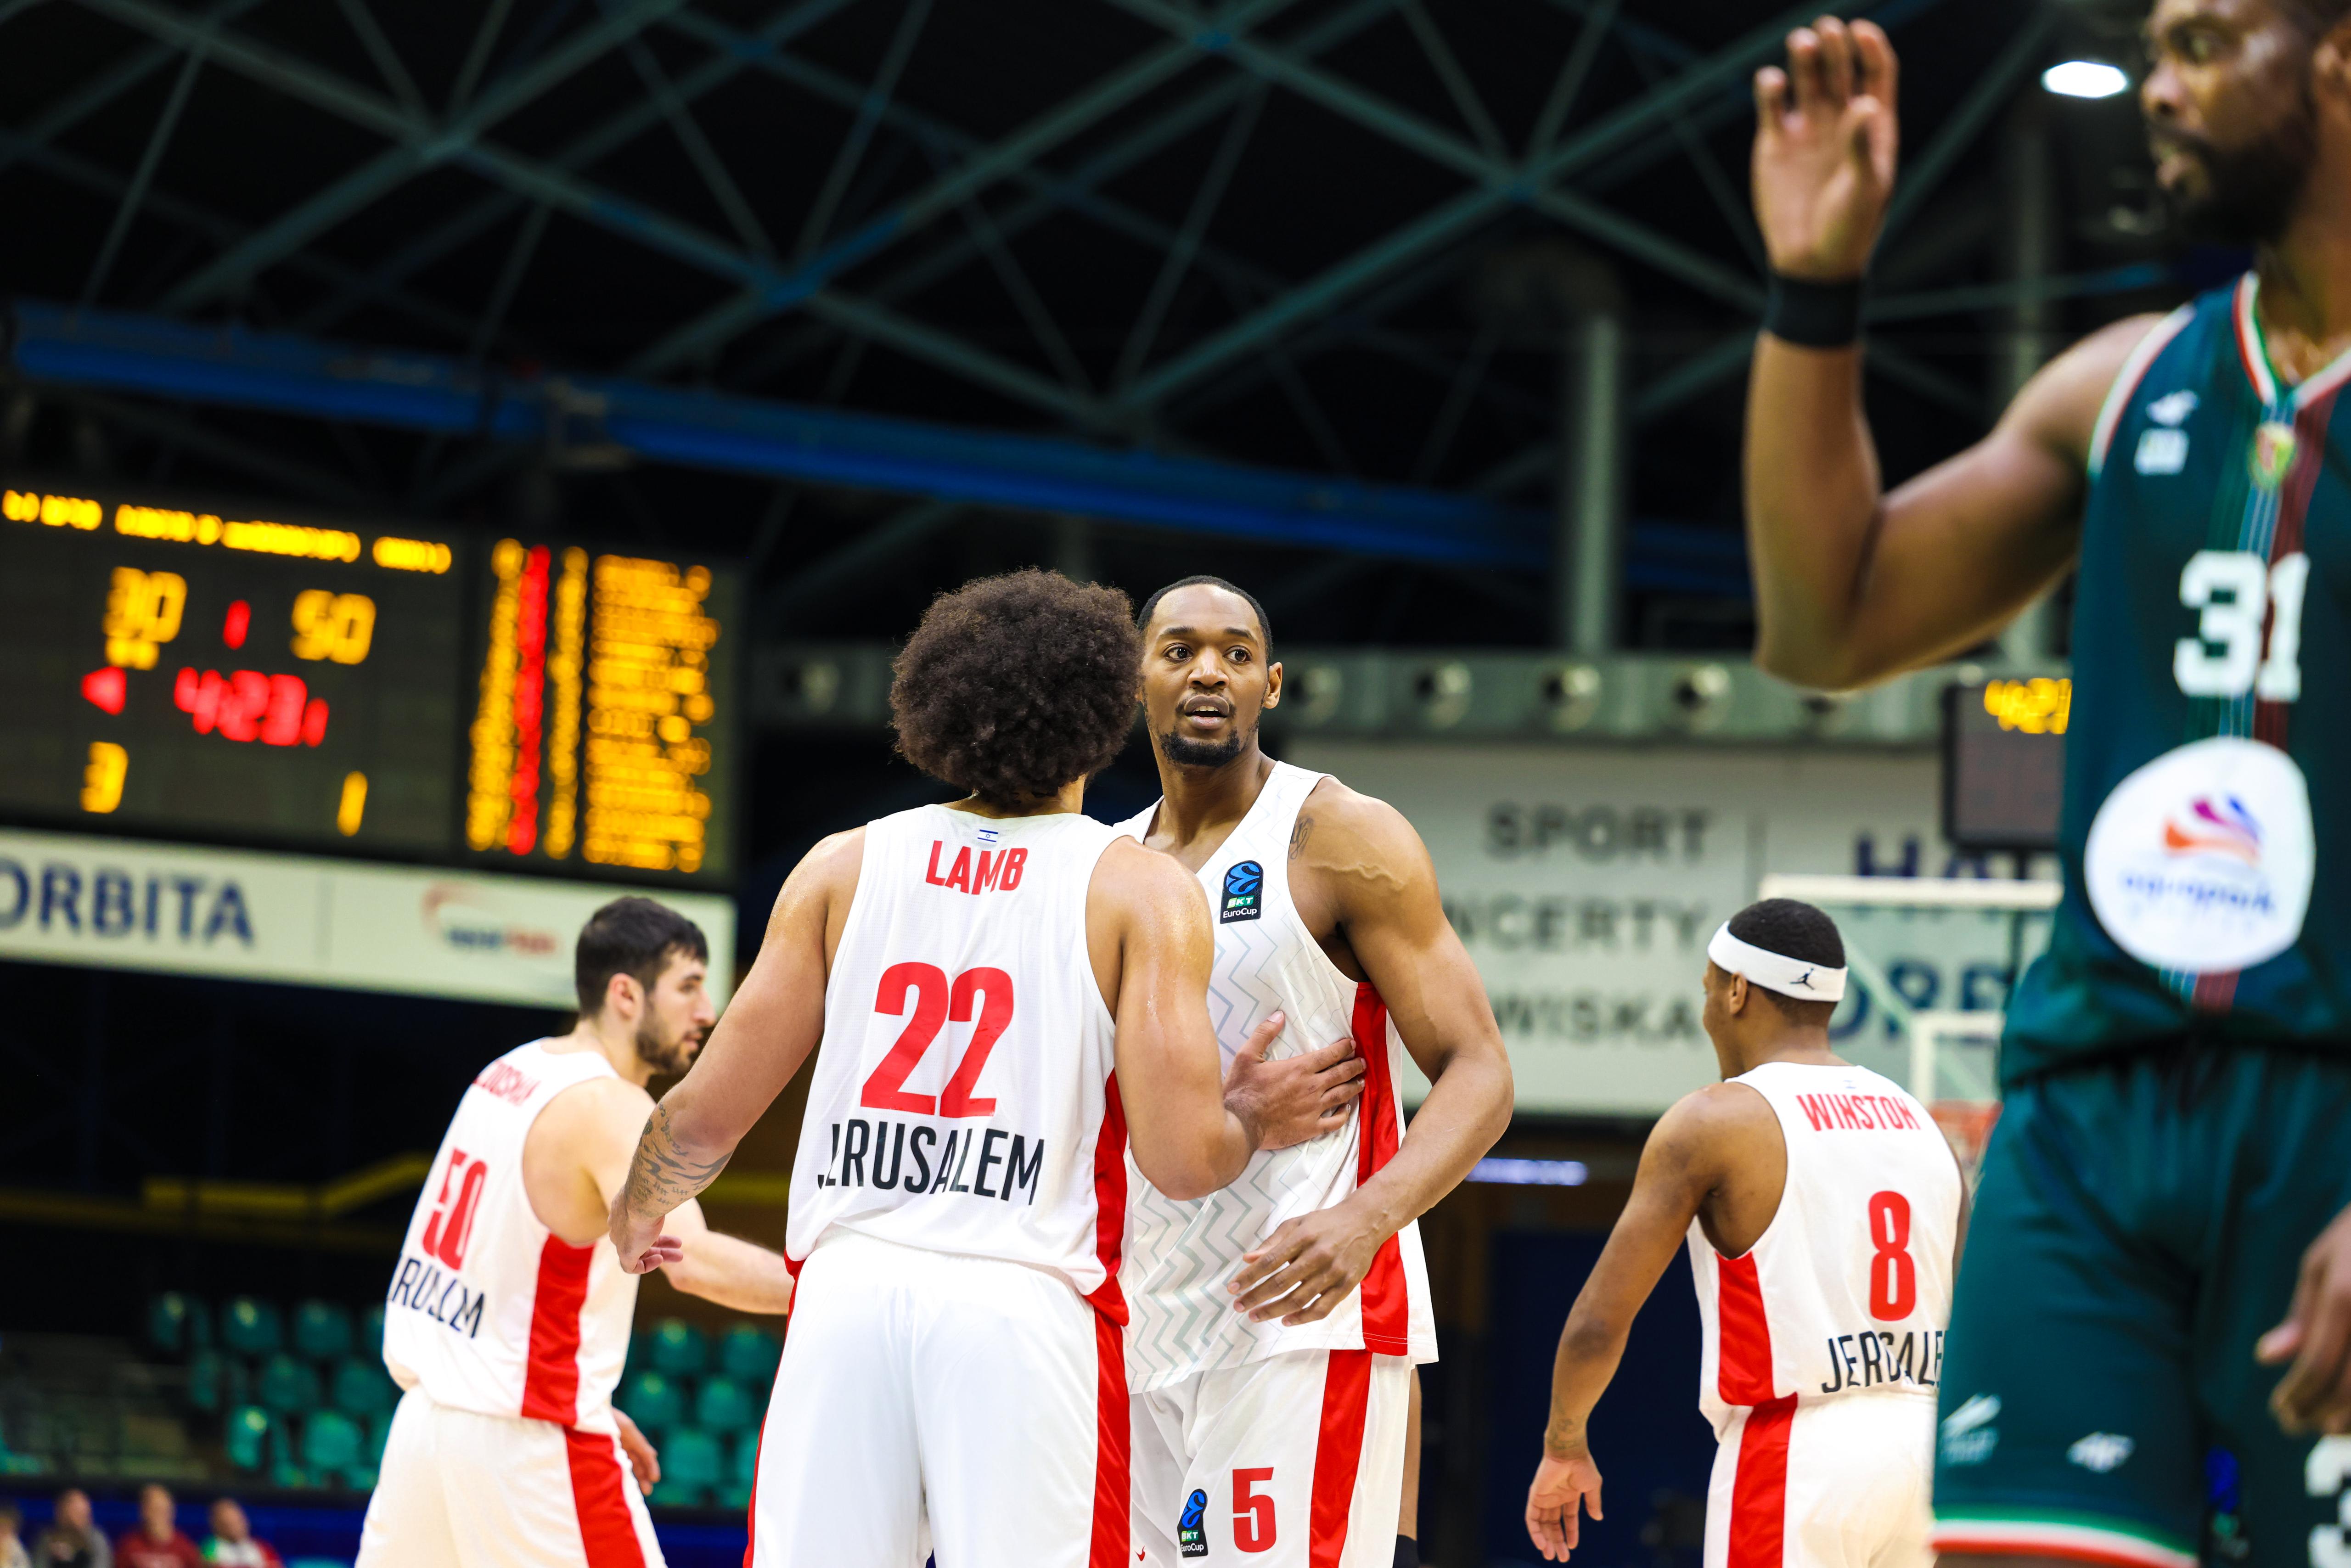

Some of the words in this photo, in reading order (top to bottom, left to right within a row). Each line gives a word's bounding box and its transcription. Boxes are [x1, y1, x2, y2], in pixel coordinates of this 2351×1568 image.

[2173, 550, 2310, 703] 31
[1487, 801, 1710, 863] SPORT
[925, 840, 1028, 895] LAMB
[1223, 907, 1257, 918] EuroCup
[1227, 897, 1254, 907] BKT
[860, 961, 1014, 1118] 22
[1796, 1094, 1921, 1132] WINSTON
[422, 1147, 488, 1271] 50
[1868, 1191, 1916, 1321] 8
[1181, 1531, 1198, 1540] BKT
[1232, 1467, 1277, 1553] 5
[1181, 1543, 1204, 1552] EuroCup
